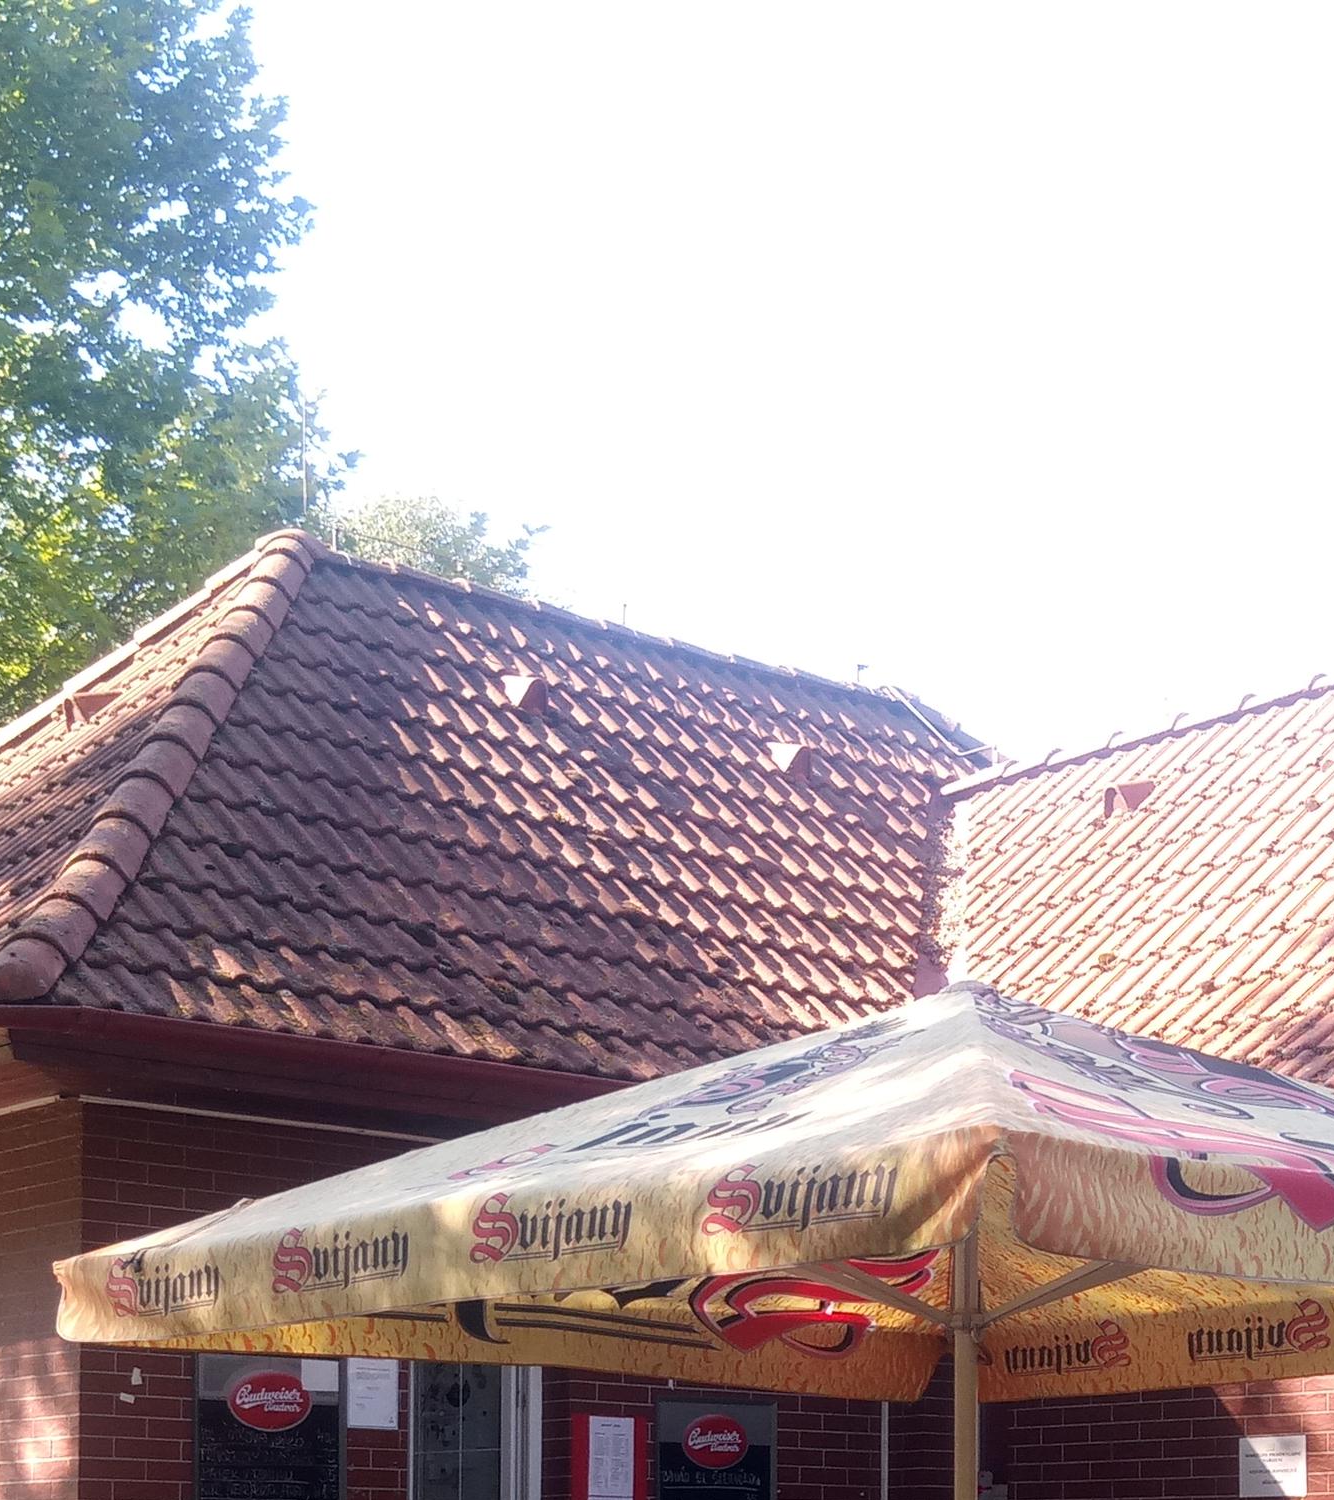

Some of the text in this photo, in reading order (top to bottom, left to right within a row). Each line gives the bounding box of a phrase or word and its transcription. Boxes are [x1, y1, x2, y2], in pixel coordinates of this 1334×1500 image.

[470, 1192, 634, 1267] Svijany
[701, 1161, 898, 1237] Svijany
[105, 1250, 221, 1318] Svijany
[272, 1225, 410, 1294] Svijany
[235, 1384, 303, 1408] Budweiser
[688, 1428, 742, 1449] Budweiser
